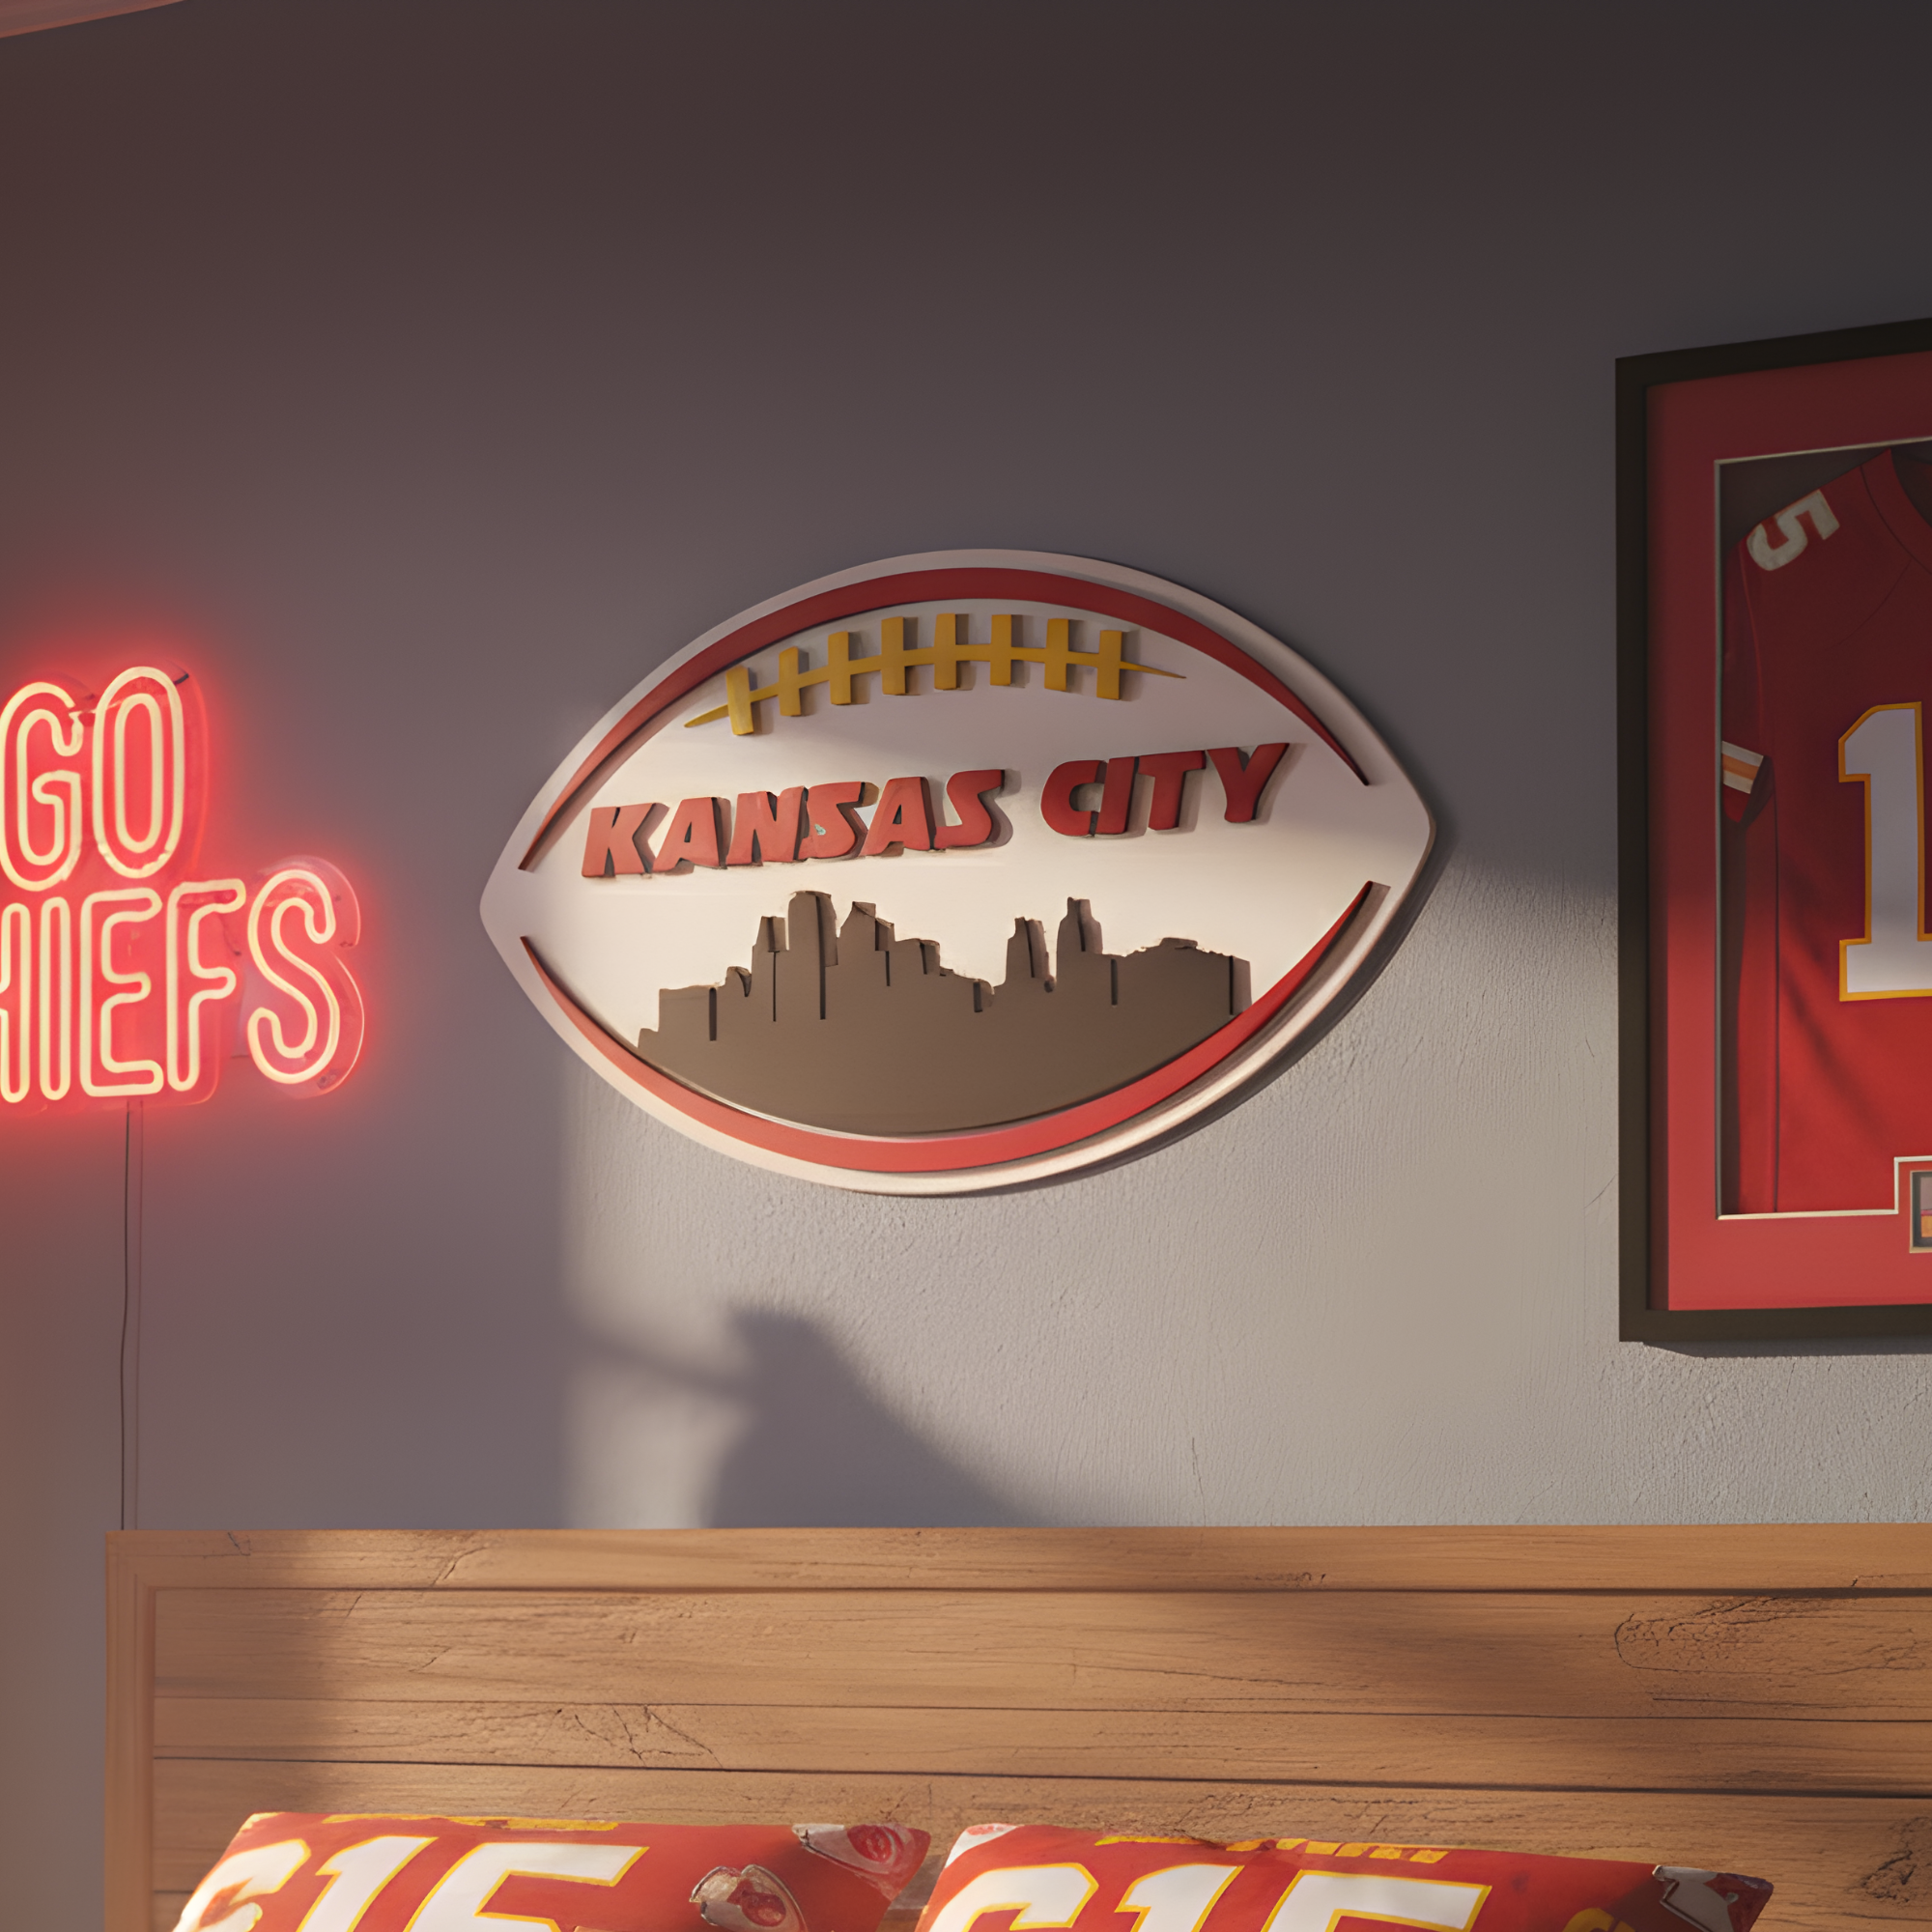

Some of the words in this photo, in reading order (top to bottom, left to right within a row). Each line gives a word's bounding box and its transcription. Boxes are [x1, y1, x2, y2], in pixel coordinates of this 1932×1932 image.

[0, 666, 185, 892] GO
[582, 769, 1008, 878] KANSAS
[1040, 742, 1291, 837] CITY
